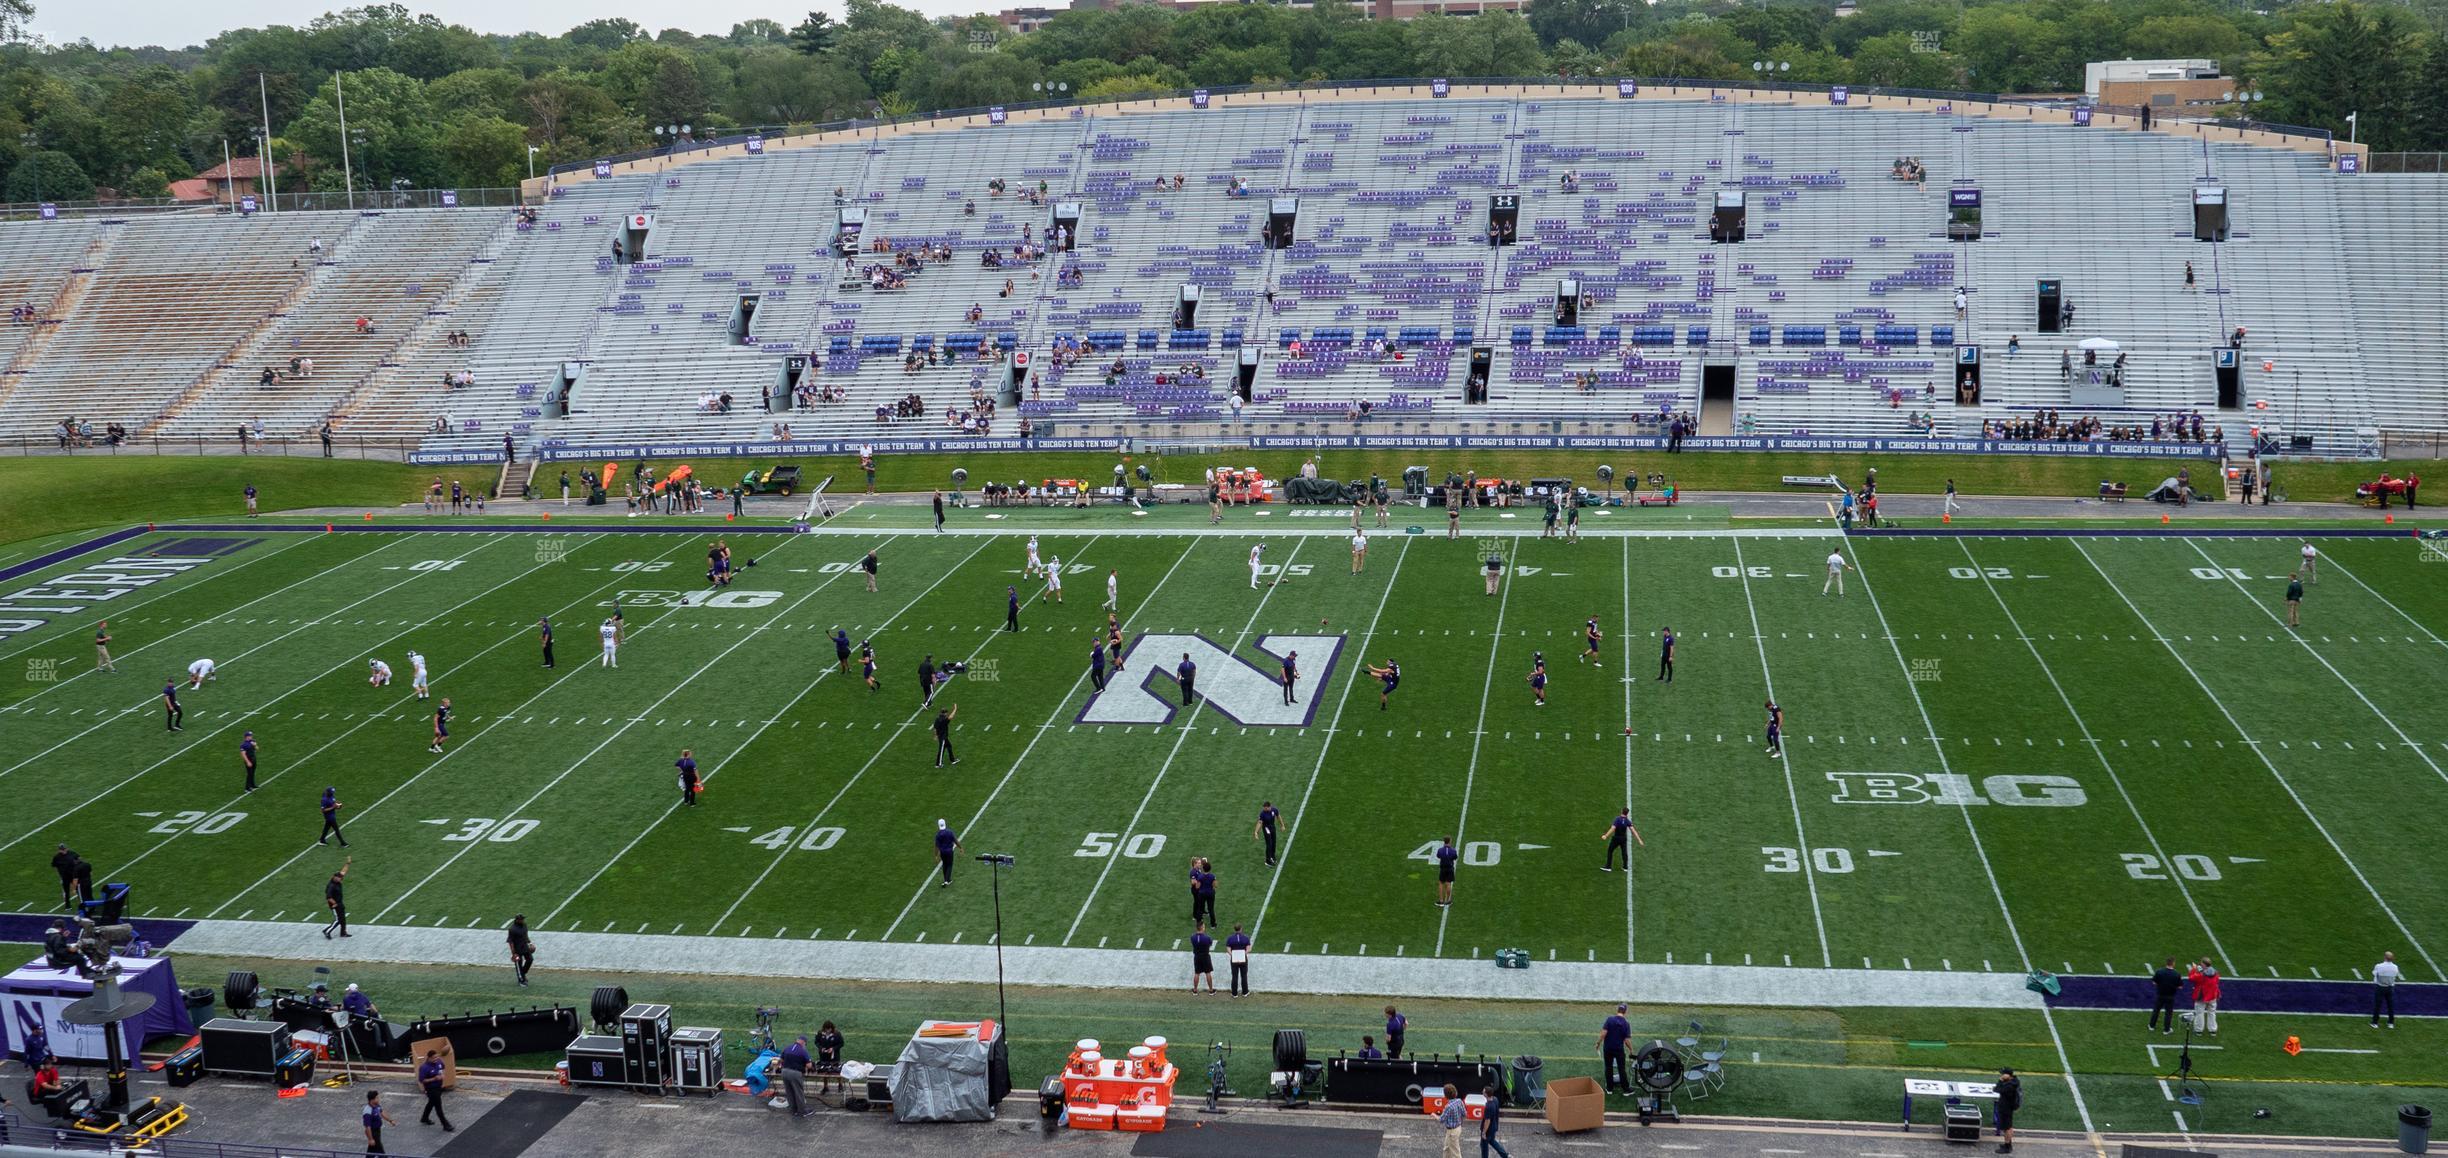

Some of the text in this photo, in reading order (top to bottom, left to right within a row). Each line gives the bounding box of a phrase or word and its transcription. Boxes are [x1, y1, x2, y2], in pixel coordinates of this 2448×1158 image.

[1834, 91, 1845, 100] 110
[2078, 112, 2088, 120] 111
[597, 166, 609, 174] 104
[2342, 160, 2355, 170] 112
[243, 200, 255, 209] 102
[43, 208, 54, 216] 101
[418, 454, 452, 462] CHICAGO'S
[1073, 634, 1347, 727] N
[147, 811, 248, 834] 20
[441, 818, 540, 842] 30
[750, 826, 846, 850] 40
[1073, 832, 1167, 858] 50
[1762, 846, 1855, 873] 30
[2120, 853, 2222, 880] 20
[1473, 1108, 1481, 1117] G
